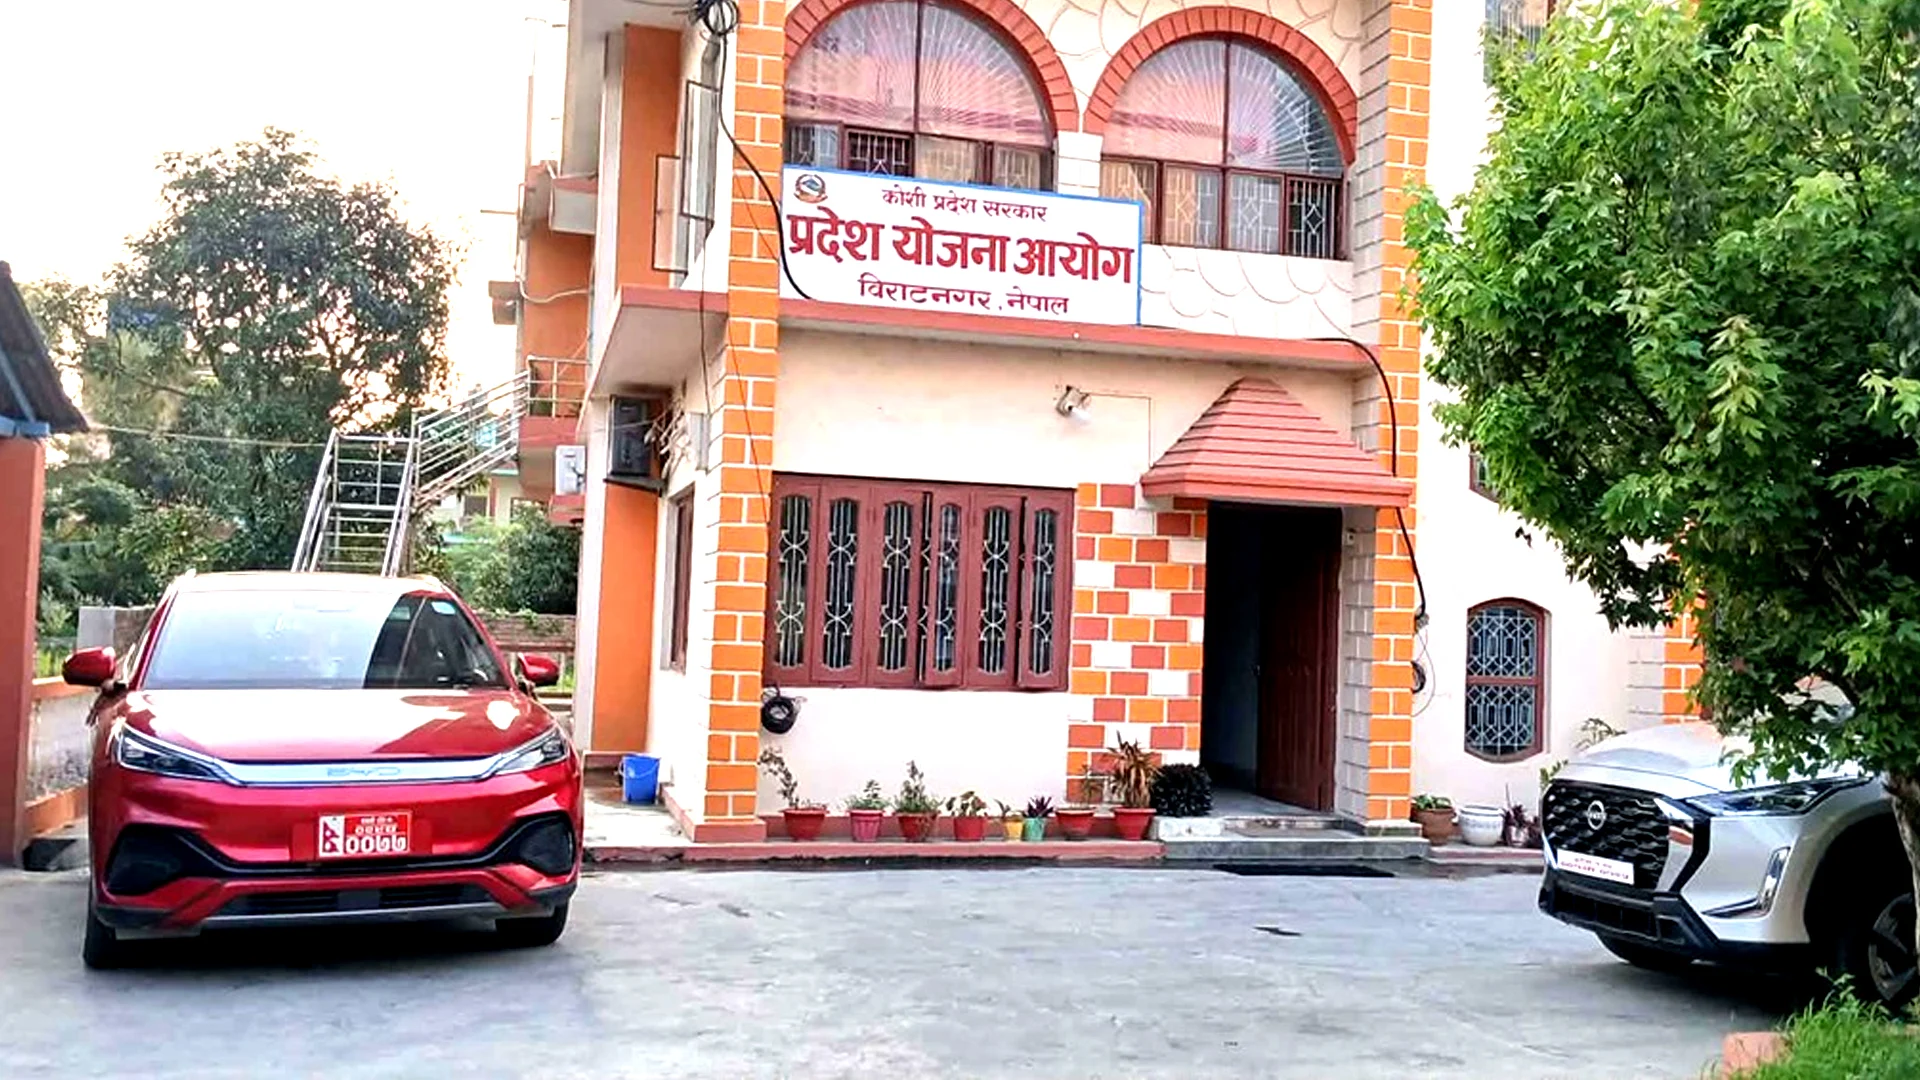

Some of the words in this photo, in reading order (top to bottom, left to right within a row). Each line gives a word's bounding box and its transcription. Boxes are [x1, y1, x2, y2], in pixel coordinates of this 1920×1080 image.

[882, 187, 926, 208] कोशी
[934, 190, 976, 216] प्रदेश
[984, 200, 1048, 222] सरकार
[786, 206, 885, 264] प्रदेश
[892, 216, 1011, 273] योजना
[1014, 232, 1135, 284] आयोग
[1006, 286, 1070, 315] नेपाल
[327, 767, 401, 777] BYD
